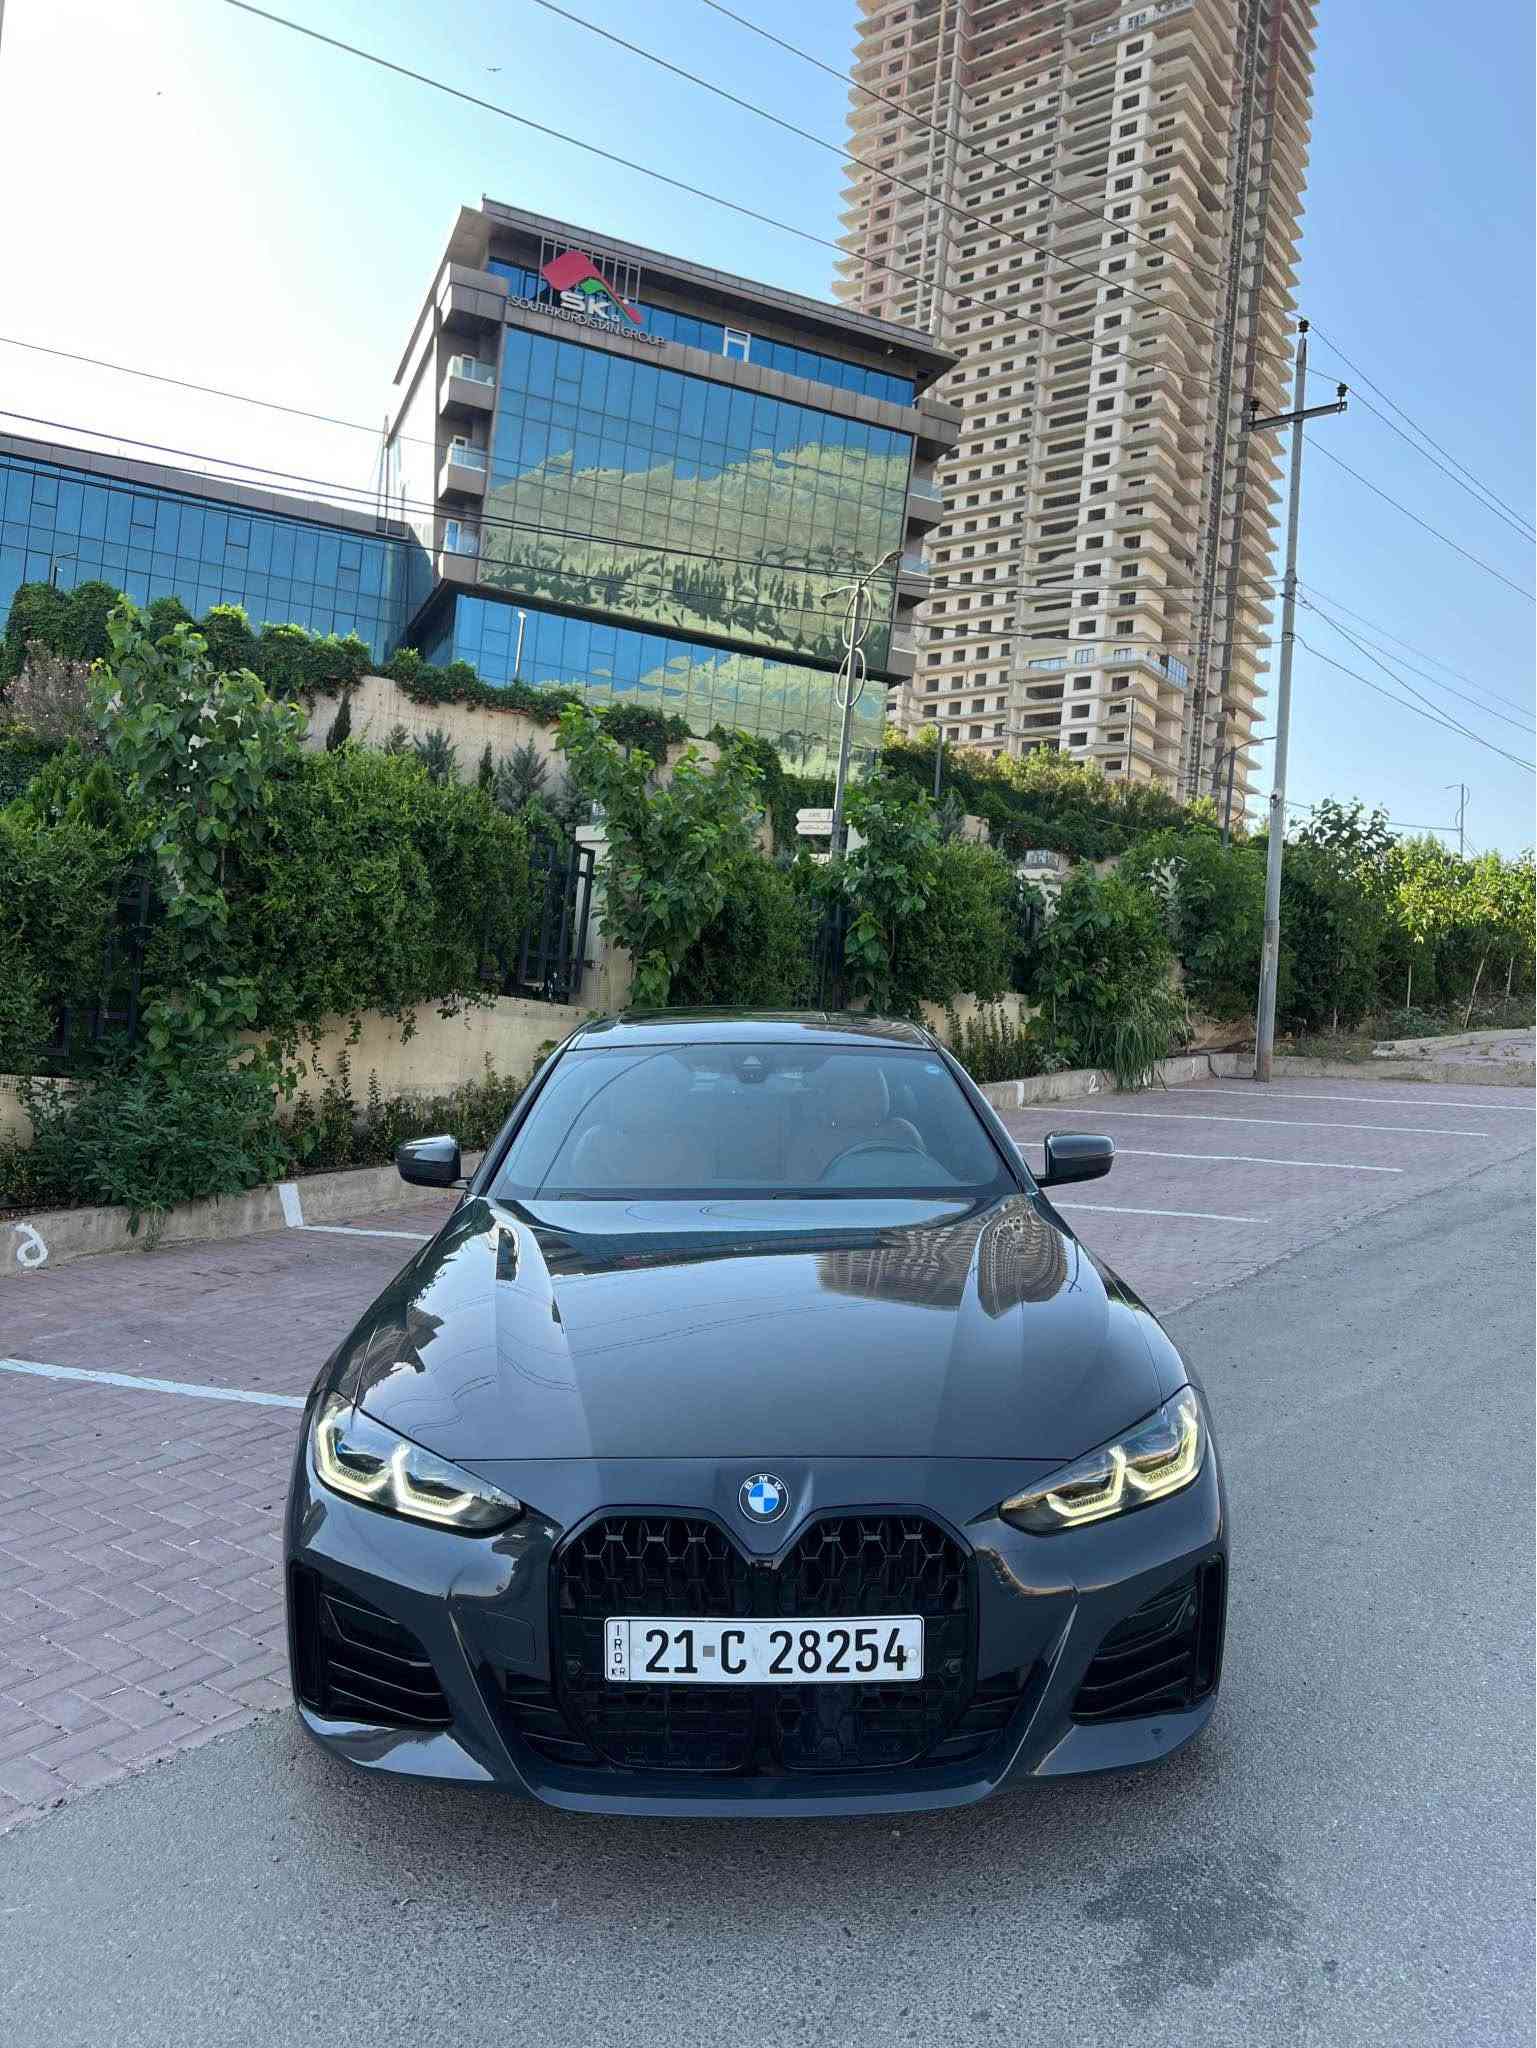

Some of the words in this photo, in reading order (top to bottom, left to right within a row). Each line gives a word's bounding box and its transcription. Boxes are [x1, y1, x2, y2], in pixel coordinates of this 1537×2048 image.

[622, 329, 667, 346] GROUP
[1088, 1074, 1099, 1094] 2
[744, 1475, 784, 1491] BMW
[645, 1629, 698, 1673] 21
[720, 1630, 747, 1674] C
[769, 1628, 907, 1674] 28254
